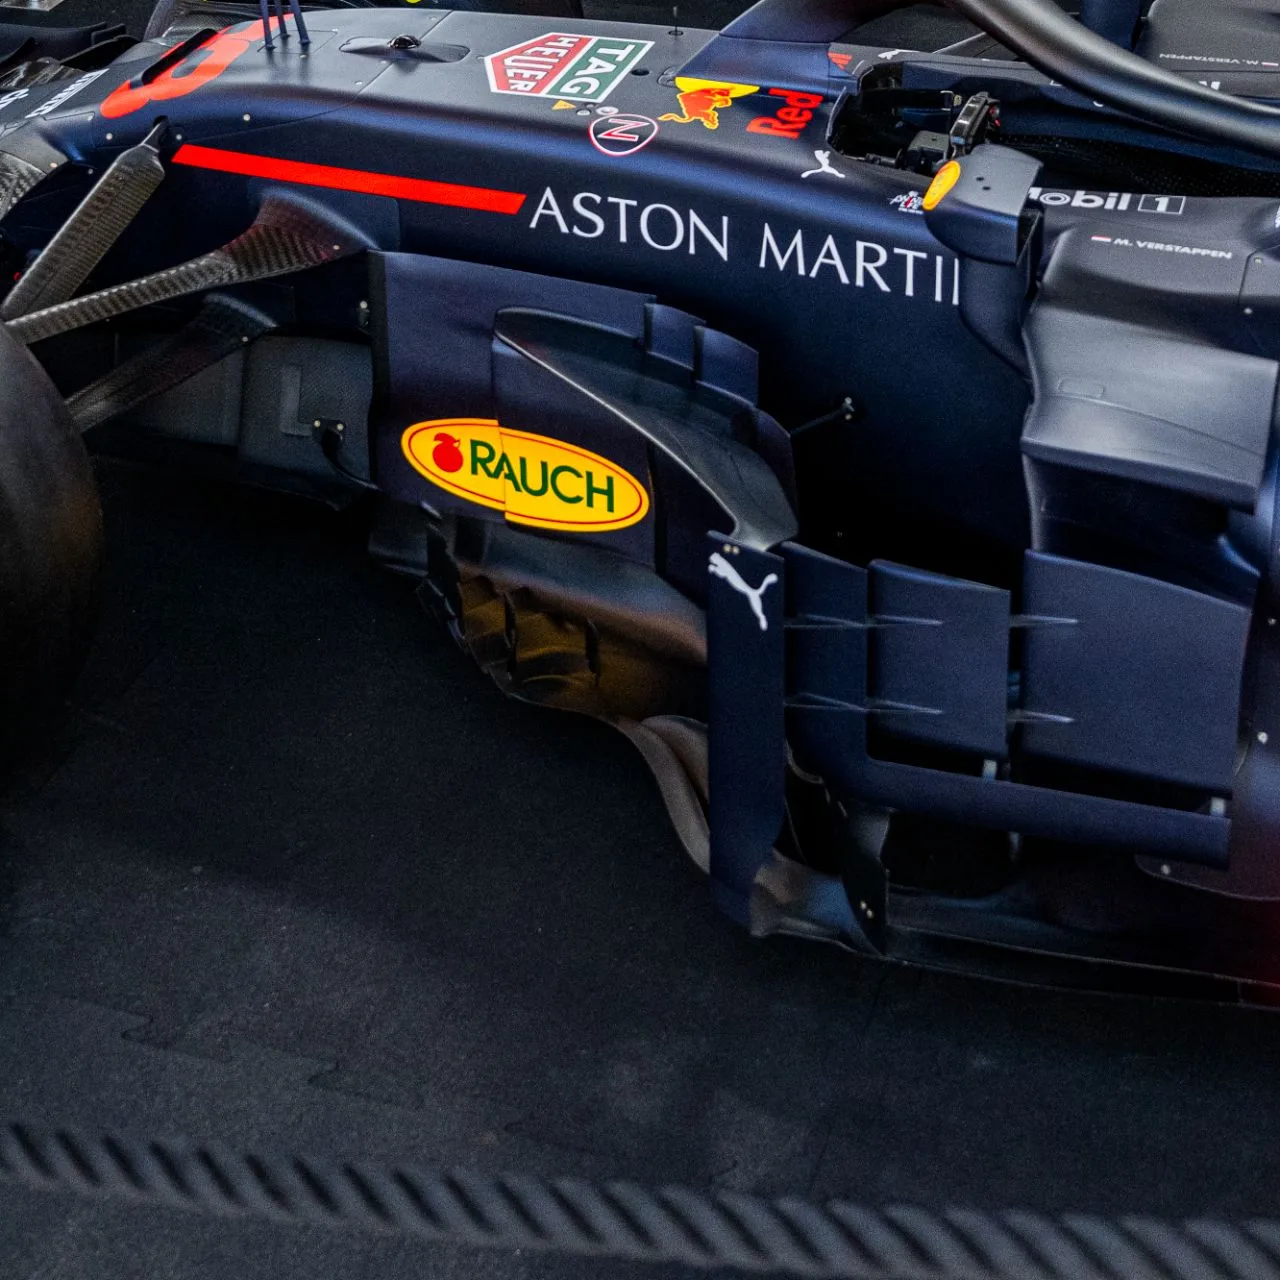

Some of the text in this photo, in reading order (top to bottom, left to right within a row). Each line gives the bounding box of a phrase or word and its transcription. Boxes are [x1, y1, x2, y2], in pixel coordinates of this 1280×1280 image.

[499, 33, 644, 98] TAG HEUER
[1159, 52, 1240, 65] VERSTAPPEN
[748, 88, 824, 139] Red
[529, 185, 730, 262] ASTON
[1113, 238, 1233, 260] M. VERSTAPPEN
[470, 438, 615, 513] RAUCH
